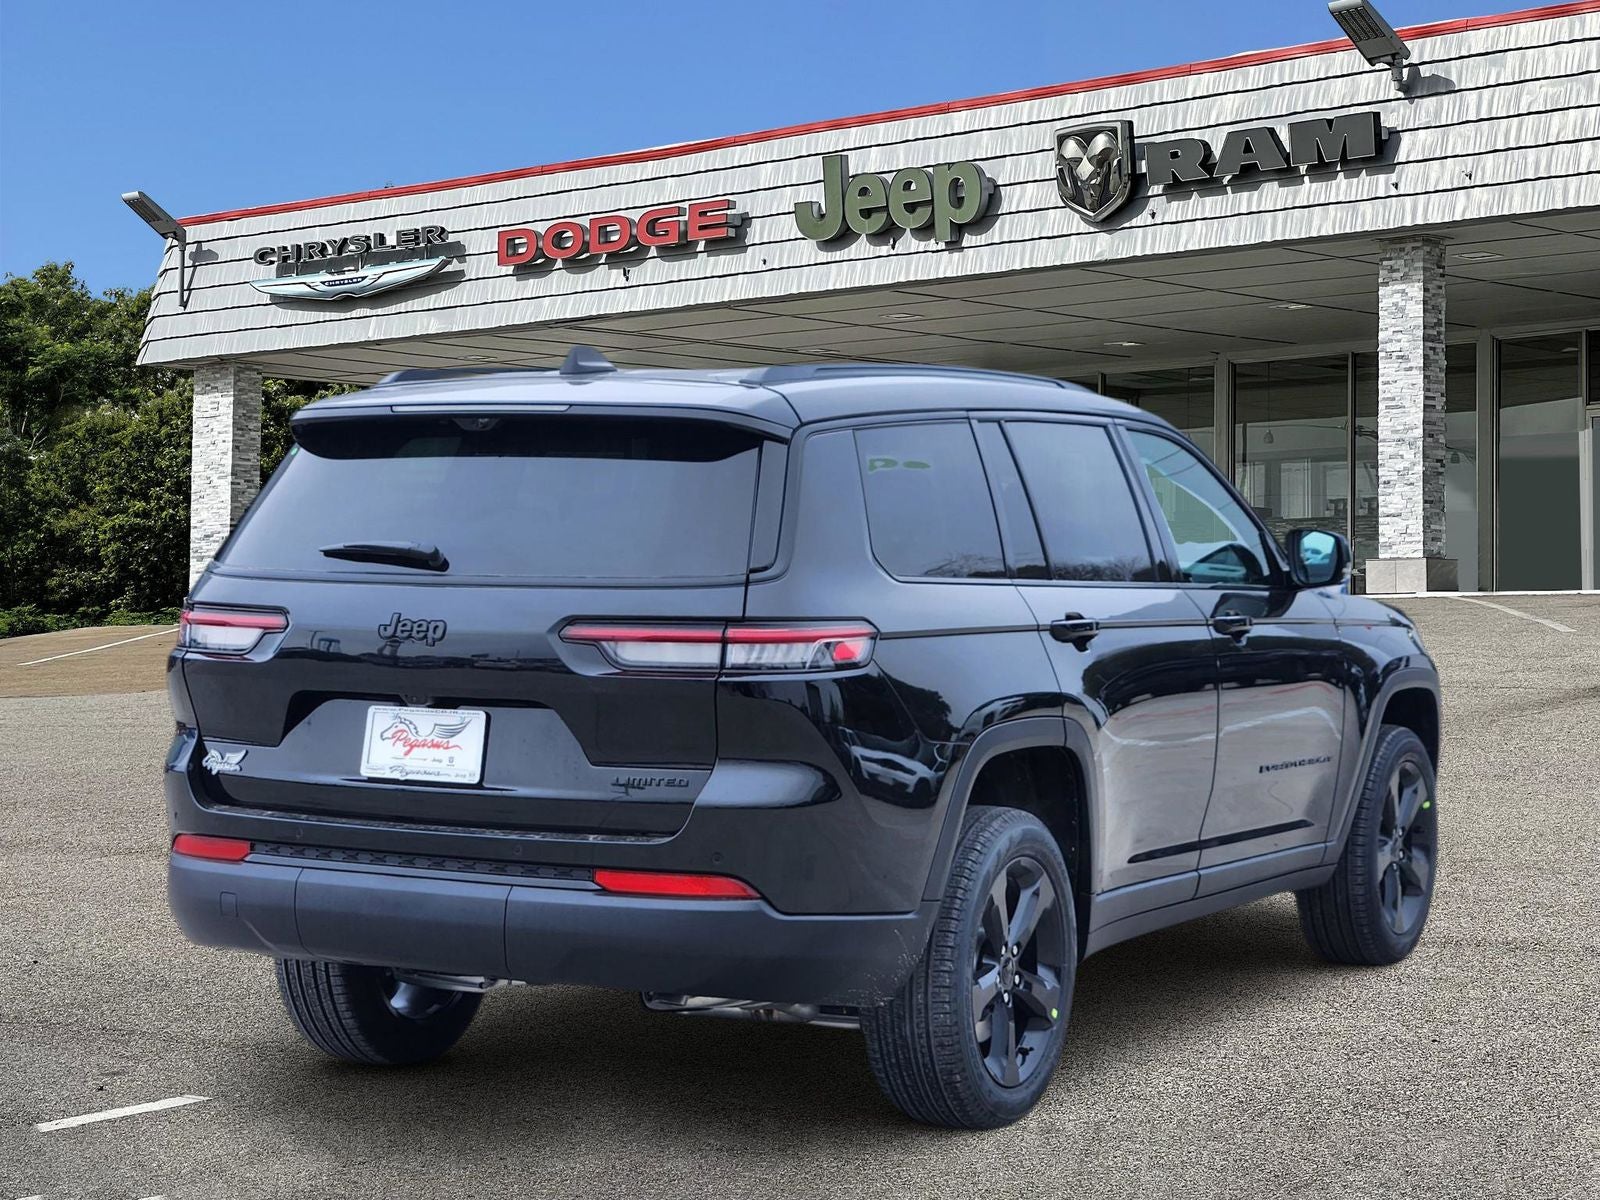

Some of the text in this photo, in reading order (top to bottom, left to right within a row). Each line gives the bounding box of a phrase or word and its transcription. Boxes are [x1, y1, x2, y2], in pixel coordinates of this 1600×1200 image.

[1145, 112, 1379, 186] RAM
[794, 154, 984, 242] Jeep
[253, 225, 448, 266] CHRYSLER
[498, 199, 734, 266] DODGE
[324, 278, 362, 286] CHRYSLER
[378, 612, 447, 647] Jeep
[391, 728, 463, 757] Pegasus
